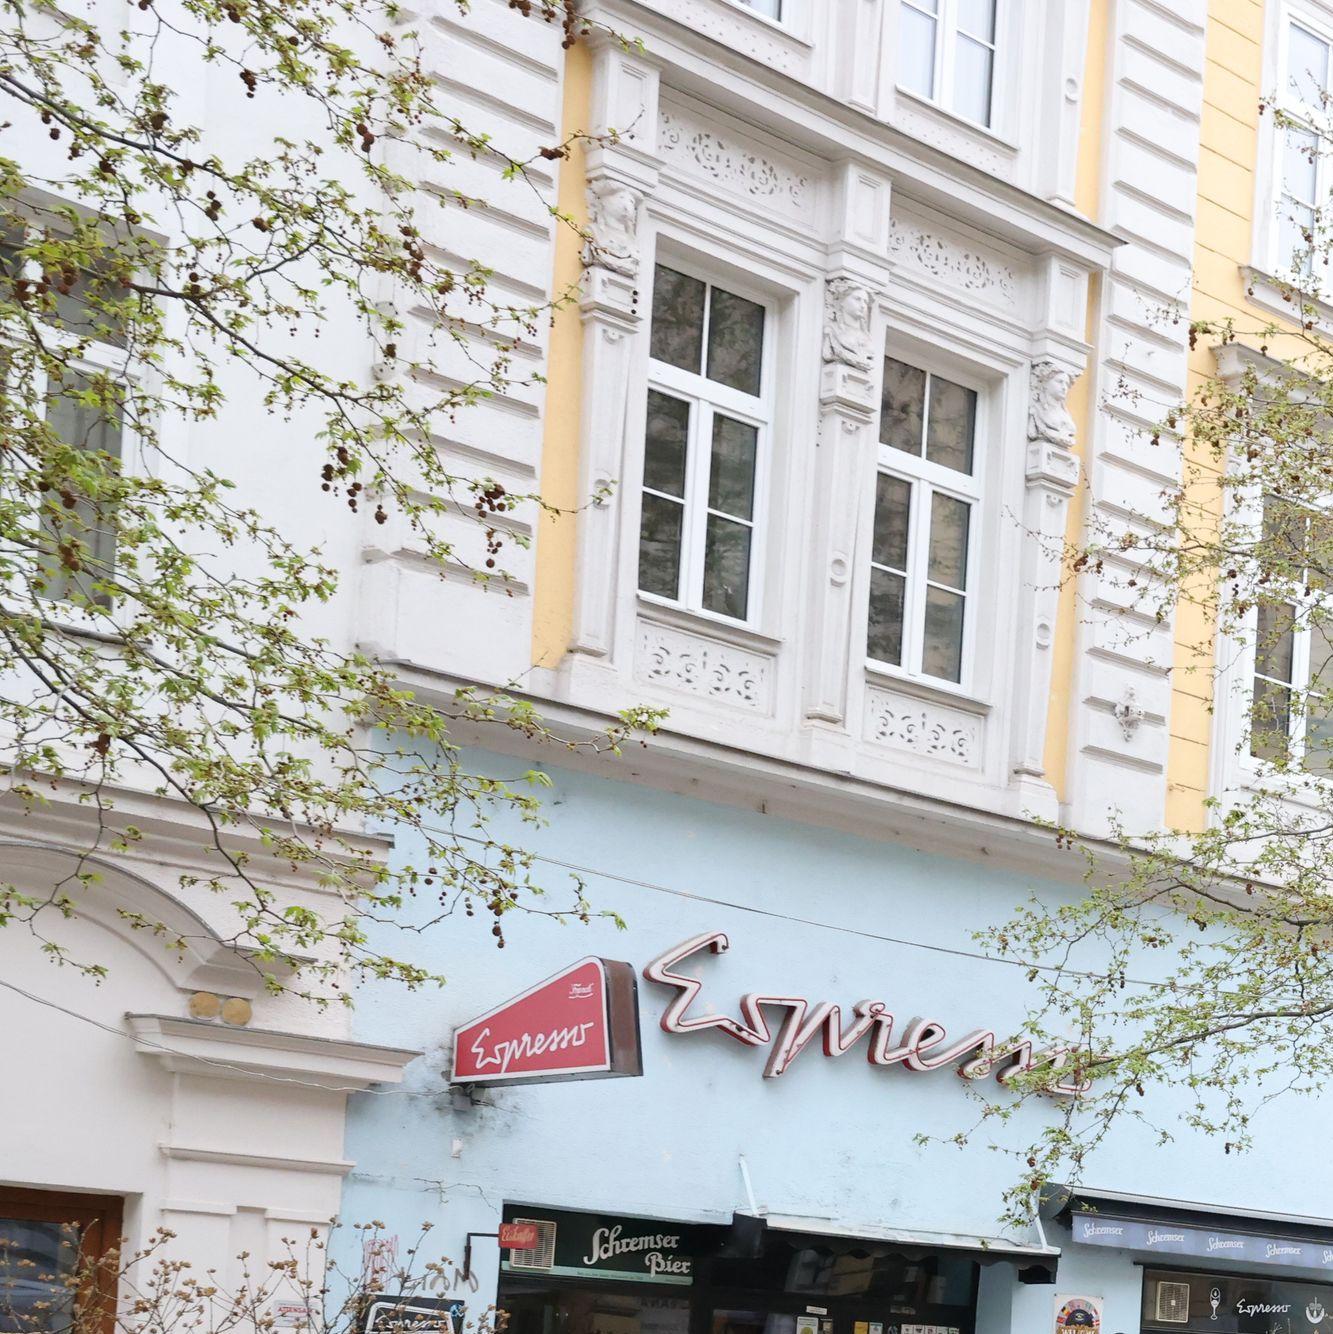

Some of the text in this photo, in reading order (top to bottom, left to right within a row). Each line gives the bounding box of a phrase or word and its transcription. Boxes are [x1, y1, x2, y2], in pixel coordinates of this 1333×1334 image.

[471, 1023, 594, 1074] Espresso
[1083, 1222, 1124, 1237] Schremser
[1146, 1230, 1185, 1246] Schremser
[583, 1225, 681, 1265] Schremser
[1206, 1237, 1244, 1252] Schremser
[1265, 1243, 1302, 1259] Schremser
[644, 1252, 691, 1278] Bier
[1236, 1298, 1291, 1317] Espresso
